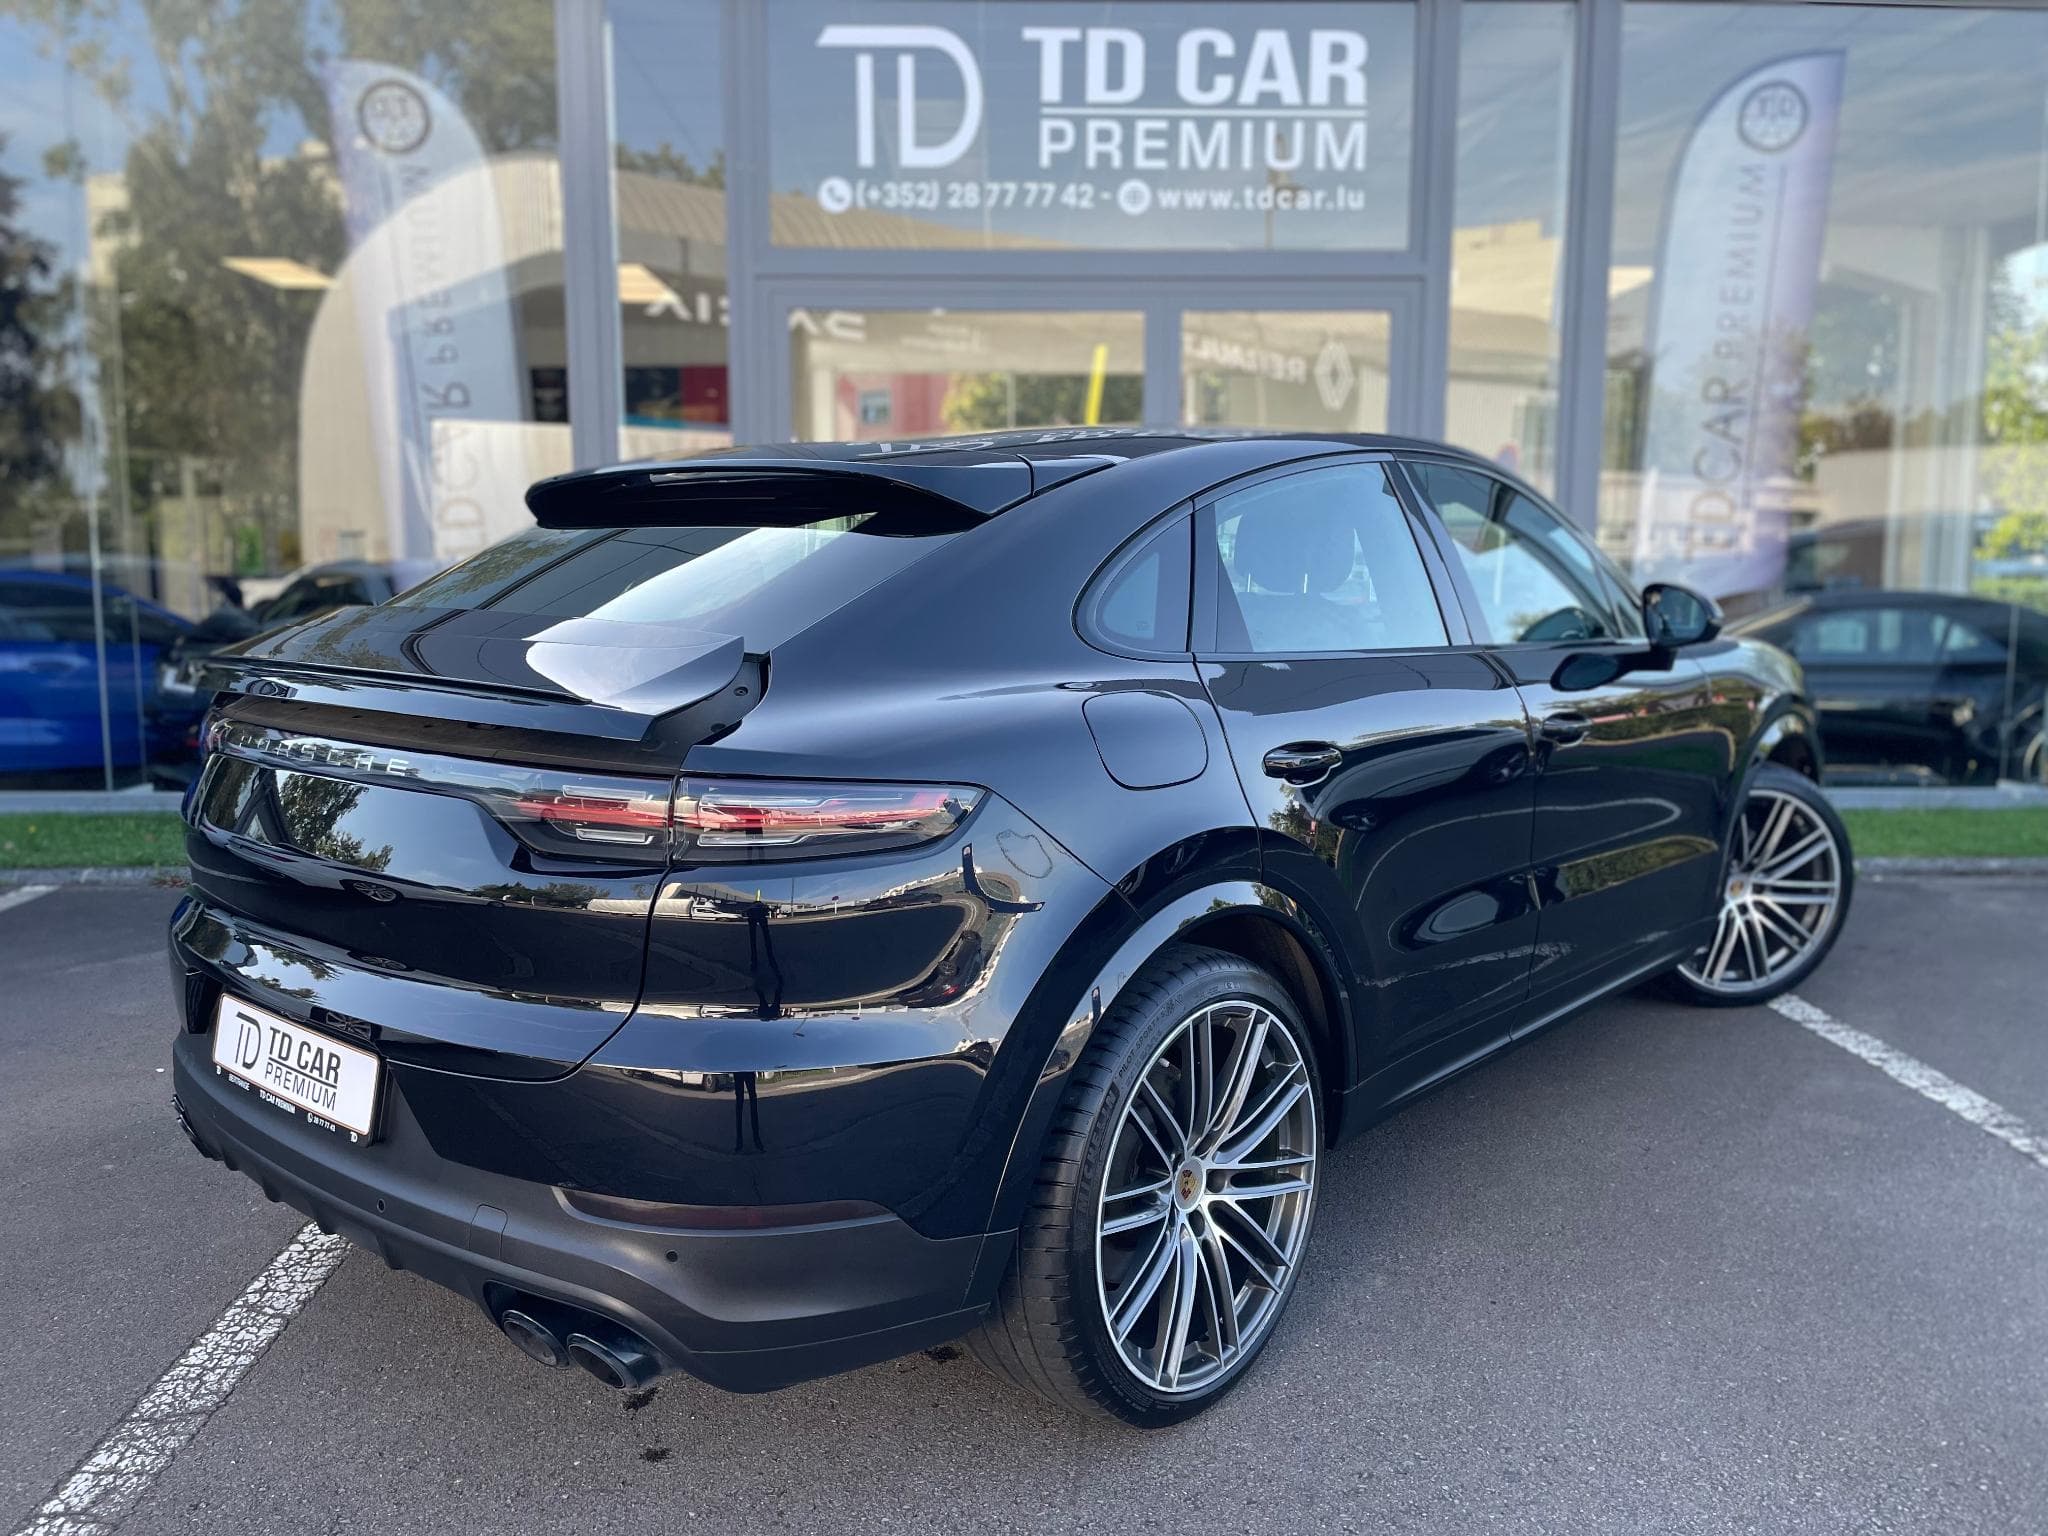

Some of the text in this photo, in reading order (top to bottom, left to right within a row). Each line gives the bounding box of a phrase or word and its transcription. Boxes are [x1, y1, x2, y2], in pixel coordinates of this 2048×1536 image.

[816, 25, 983, 167] TD
[1022, 27, 1369, 106] TD CAR
[1038, 119, 1367, 170] PREMIUM
[856, 178, 940, 210] (+352)
[947, 181, 980, 209] 28
[984, 181, 1017, 209] 77
[1023, 181, 1057, 209] 77
[1060, 181, 1096, 209] 42
[1156, 183, 1365, 211] www.tdcar.lu
[235, 1011, 261, 1070] TD
[268, 1026, 341, 1085] TD CAR
[264, 1062, 337, 1111] PREMIUM
